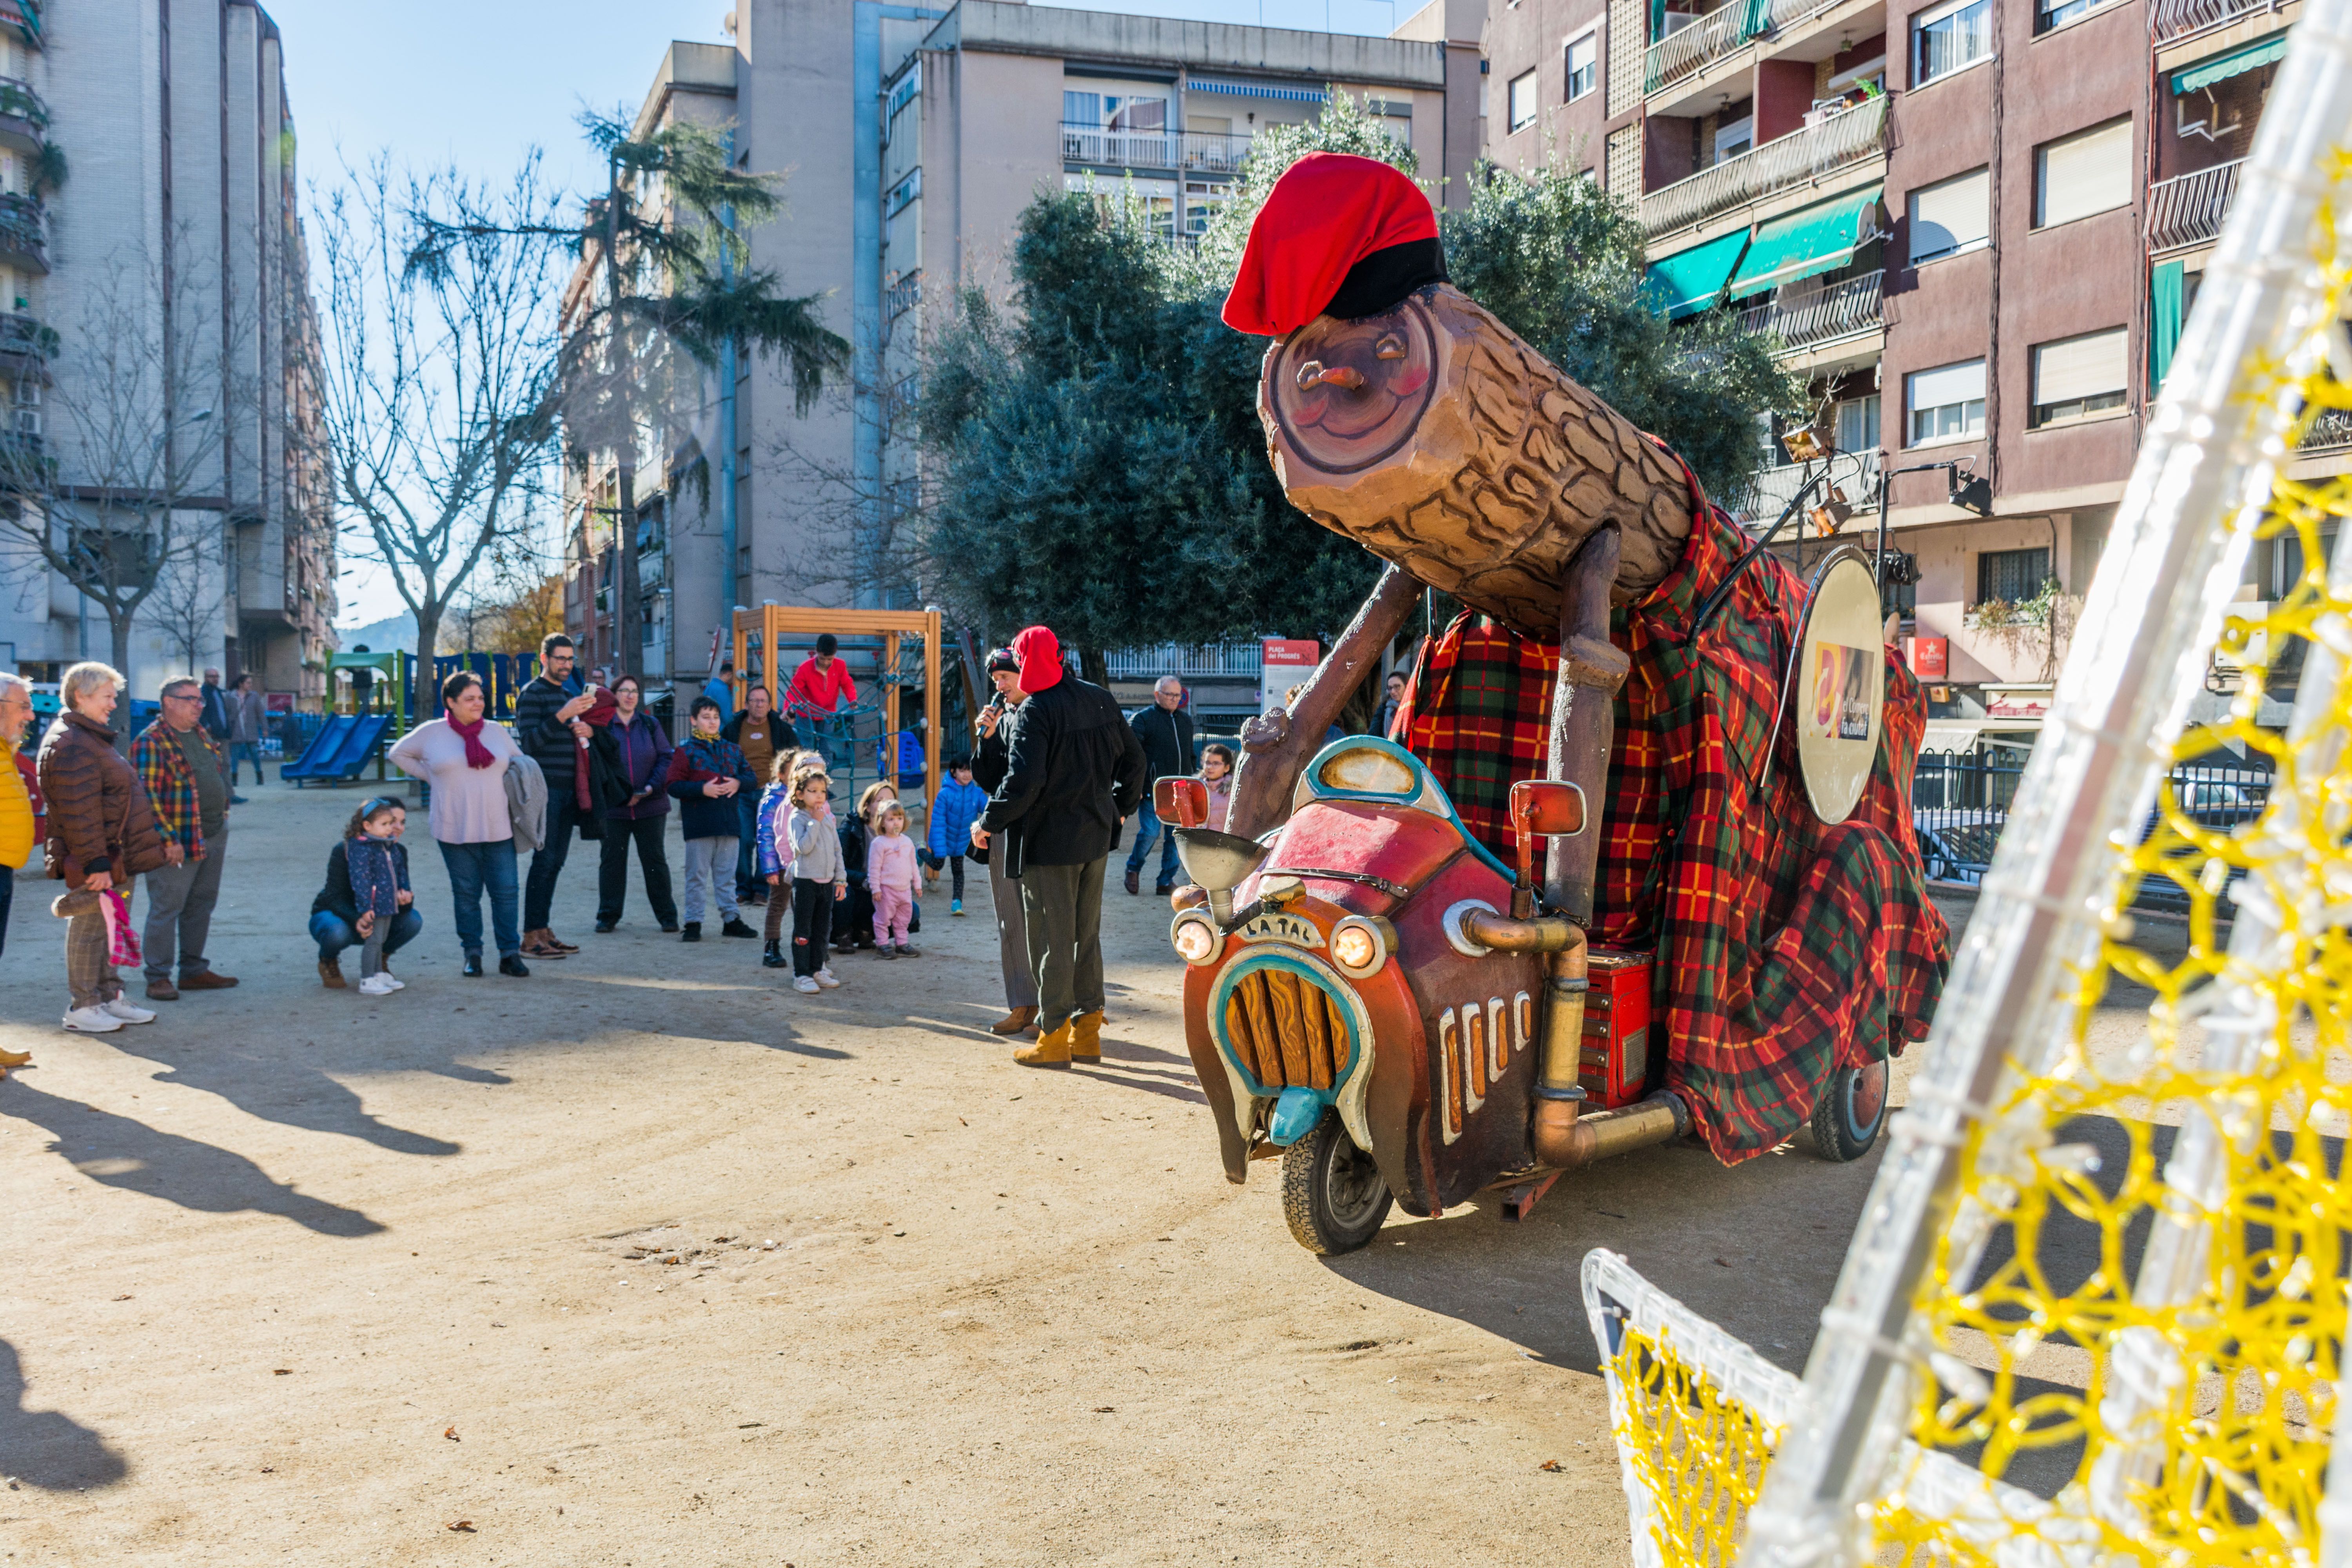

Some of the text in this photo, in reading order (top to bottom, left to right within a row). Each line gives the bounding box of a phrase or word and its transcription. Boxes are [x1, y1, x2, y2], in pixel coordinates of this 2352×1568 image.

[1843, 697, 1869, 717] el Comerç
[1841, 716, 1867, 736] fa ciutat
[1247, 919, 1271, 935] LA
